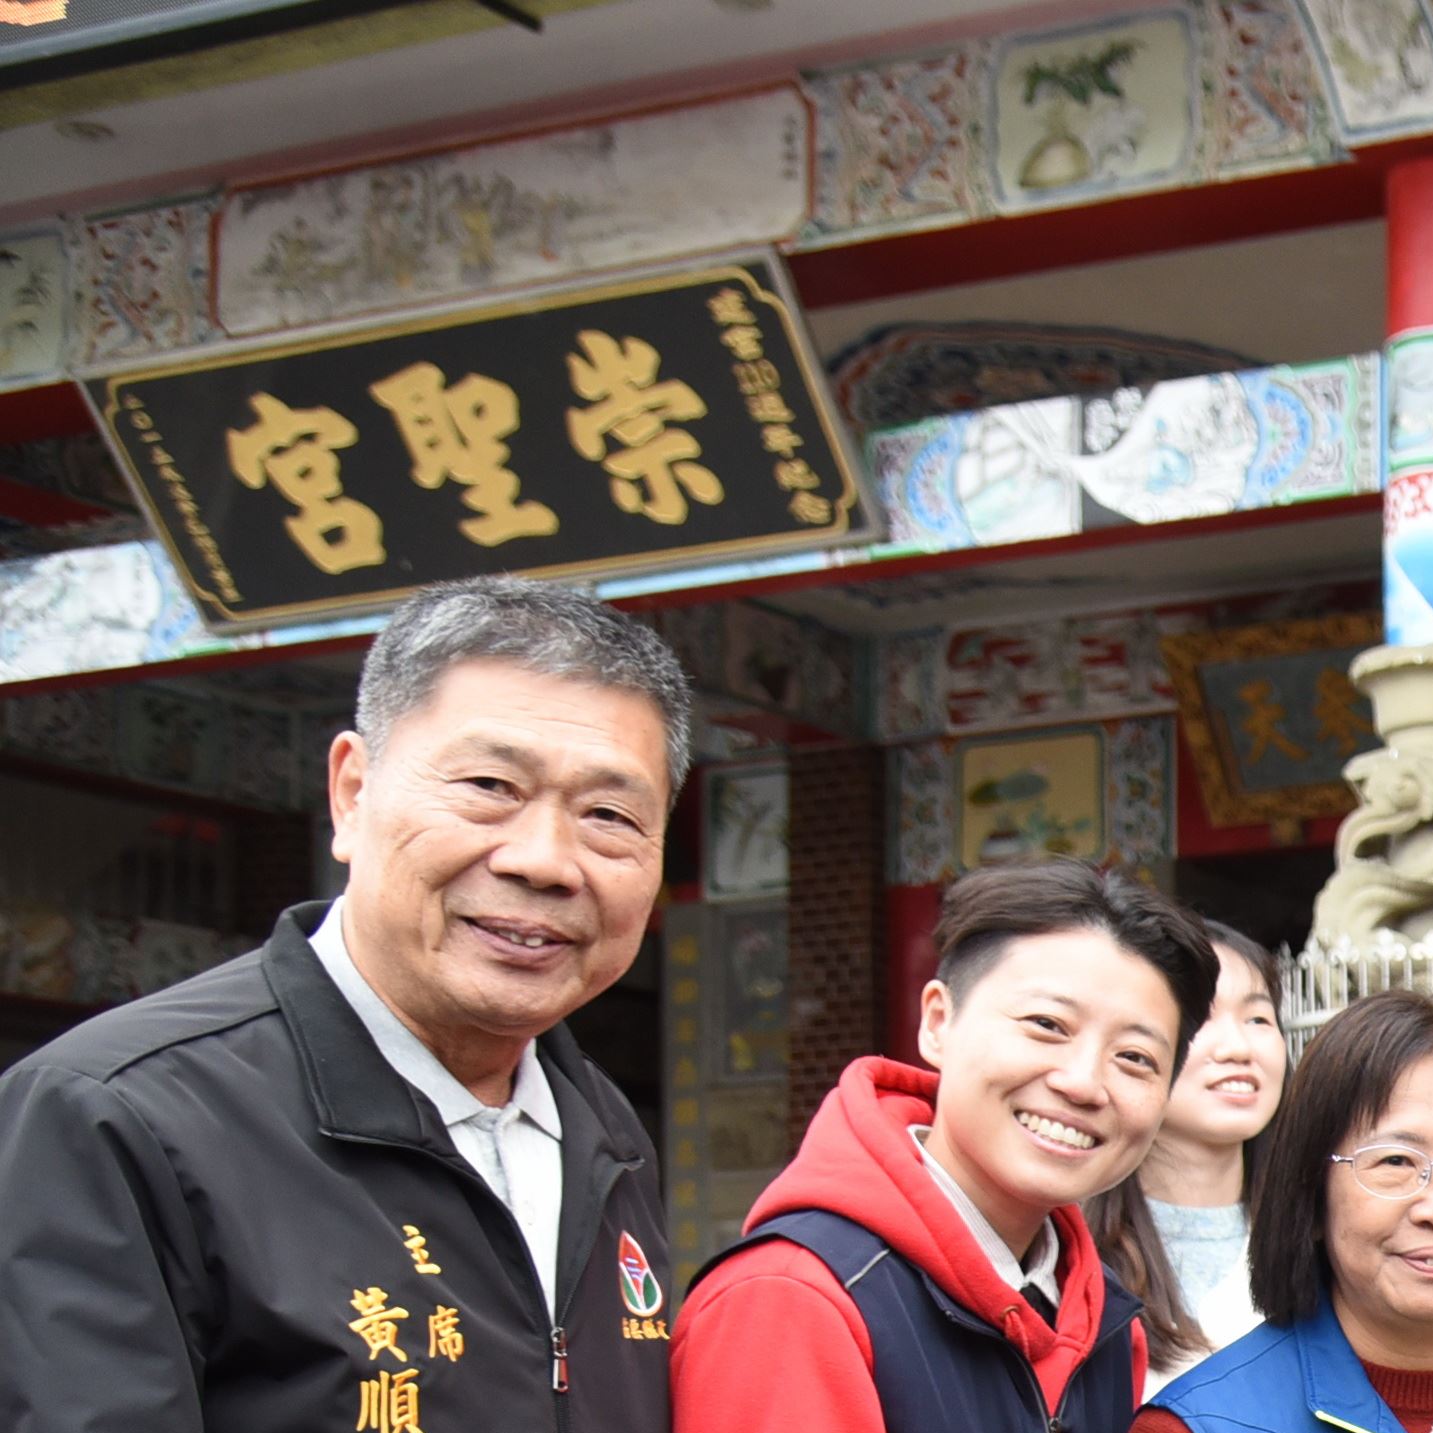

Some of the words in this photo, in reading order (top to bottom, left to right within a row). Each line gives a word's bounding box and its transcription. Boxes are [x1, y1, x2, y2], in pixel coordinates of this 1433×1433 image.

[226, 329, 725, 575] 崇聖宮
[403, 1224, 465, 1362] 主席
